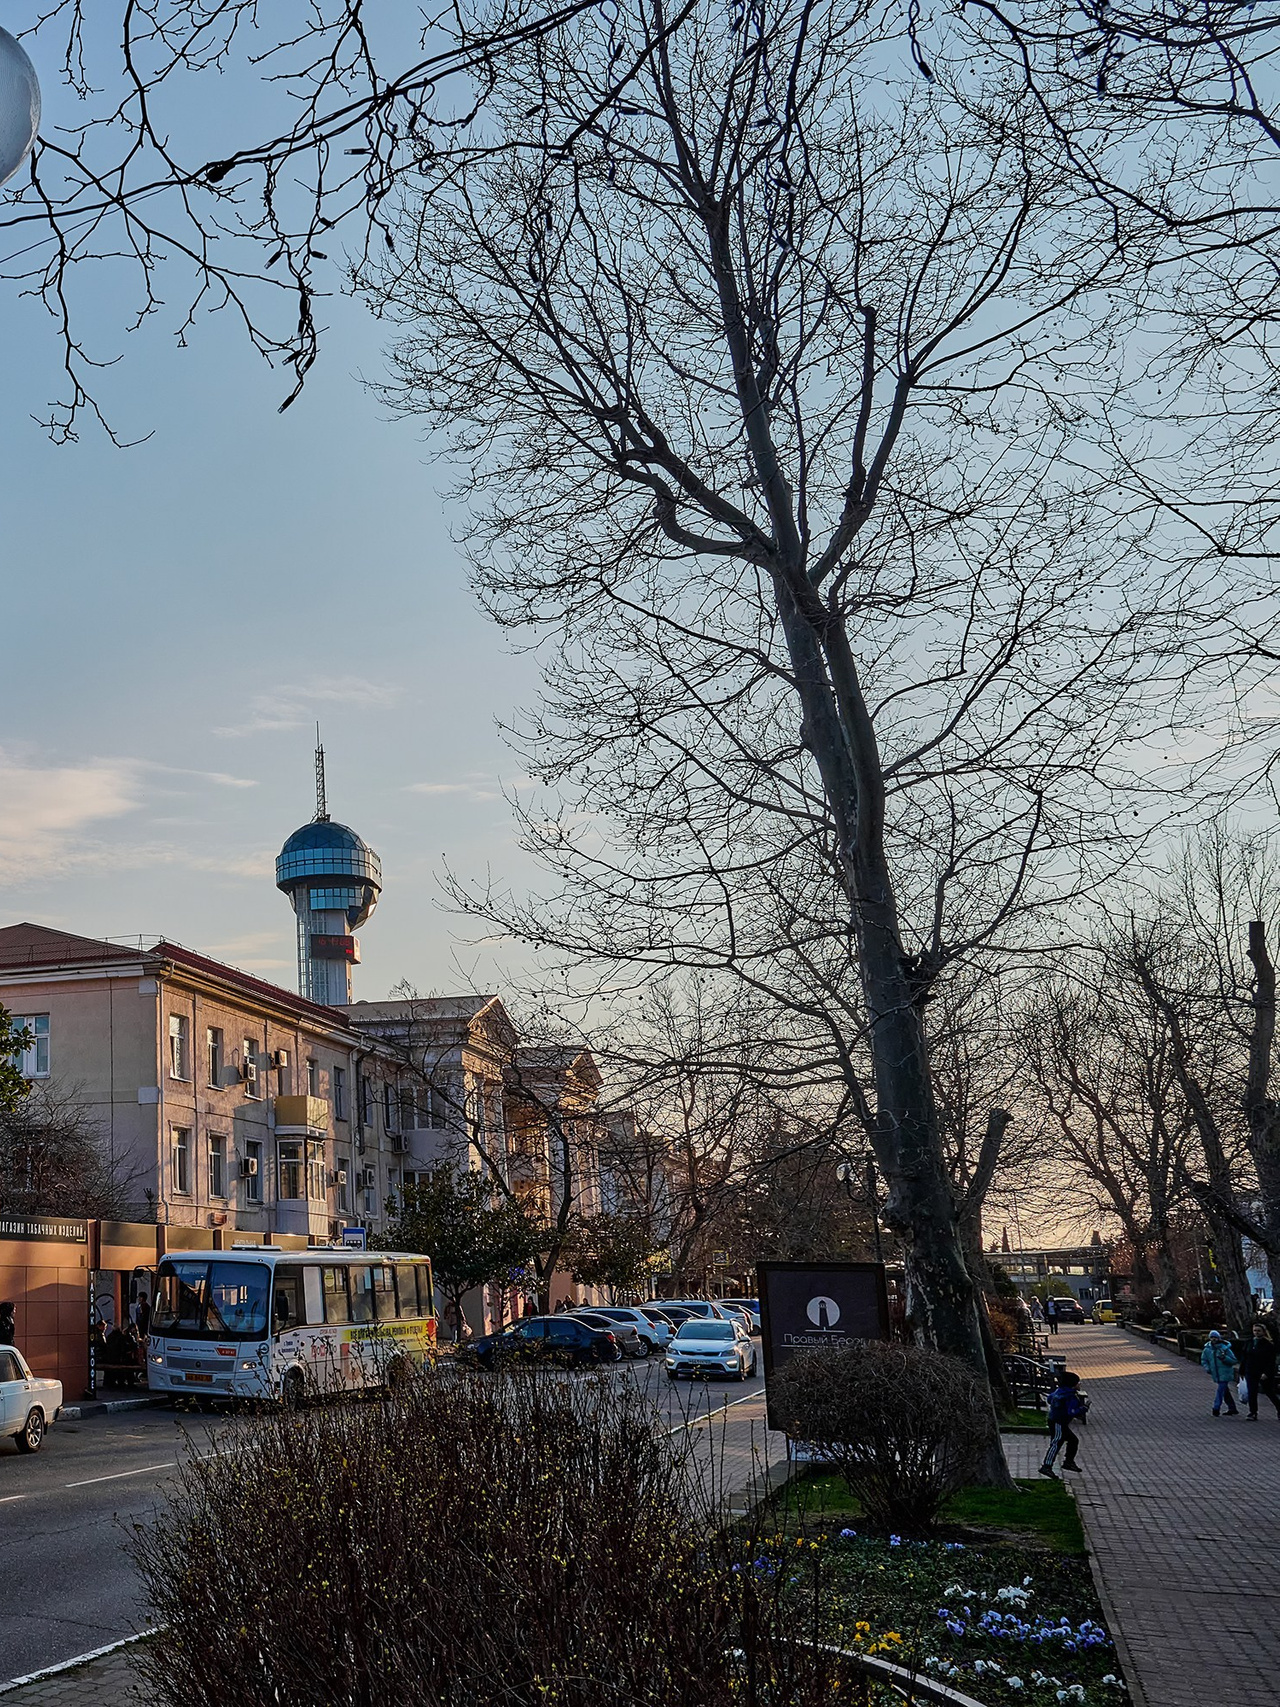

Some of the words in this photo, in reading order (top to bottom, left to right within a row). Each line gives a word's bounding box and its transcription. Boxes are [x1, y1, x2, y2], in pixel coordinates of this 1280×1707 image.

[26, 1223, 57, 1236] ТАБАЧНЫХ
[58, 1224, 84, 1238] ИЗДЕЛИЙ
[783, 1333, 827, 1345] Правый
